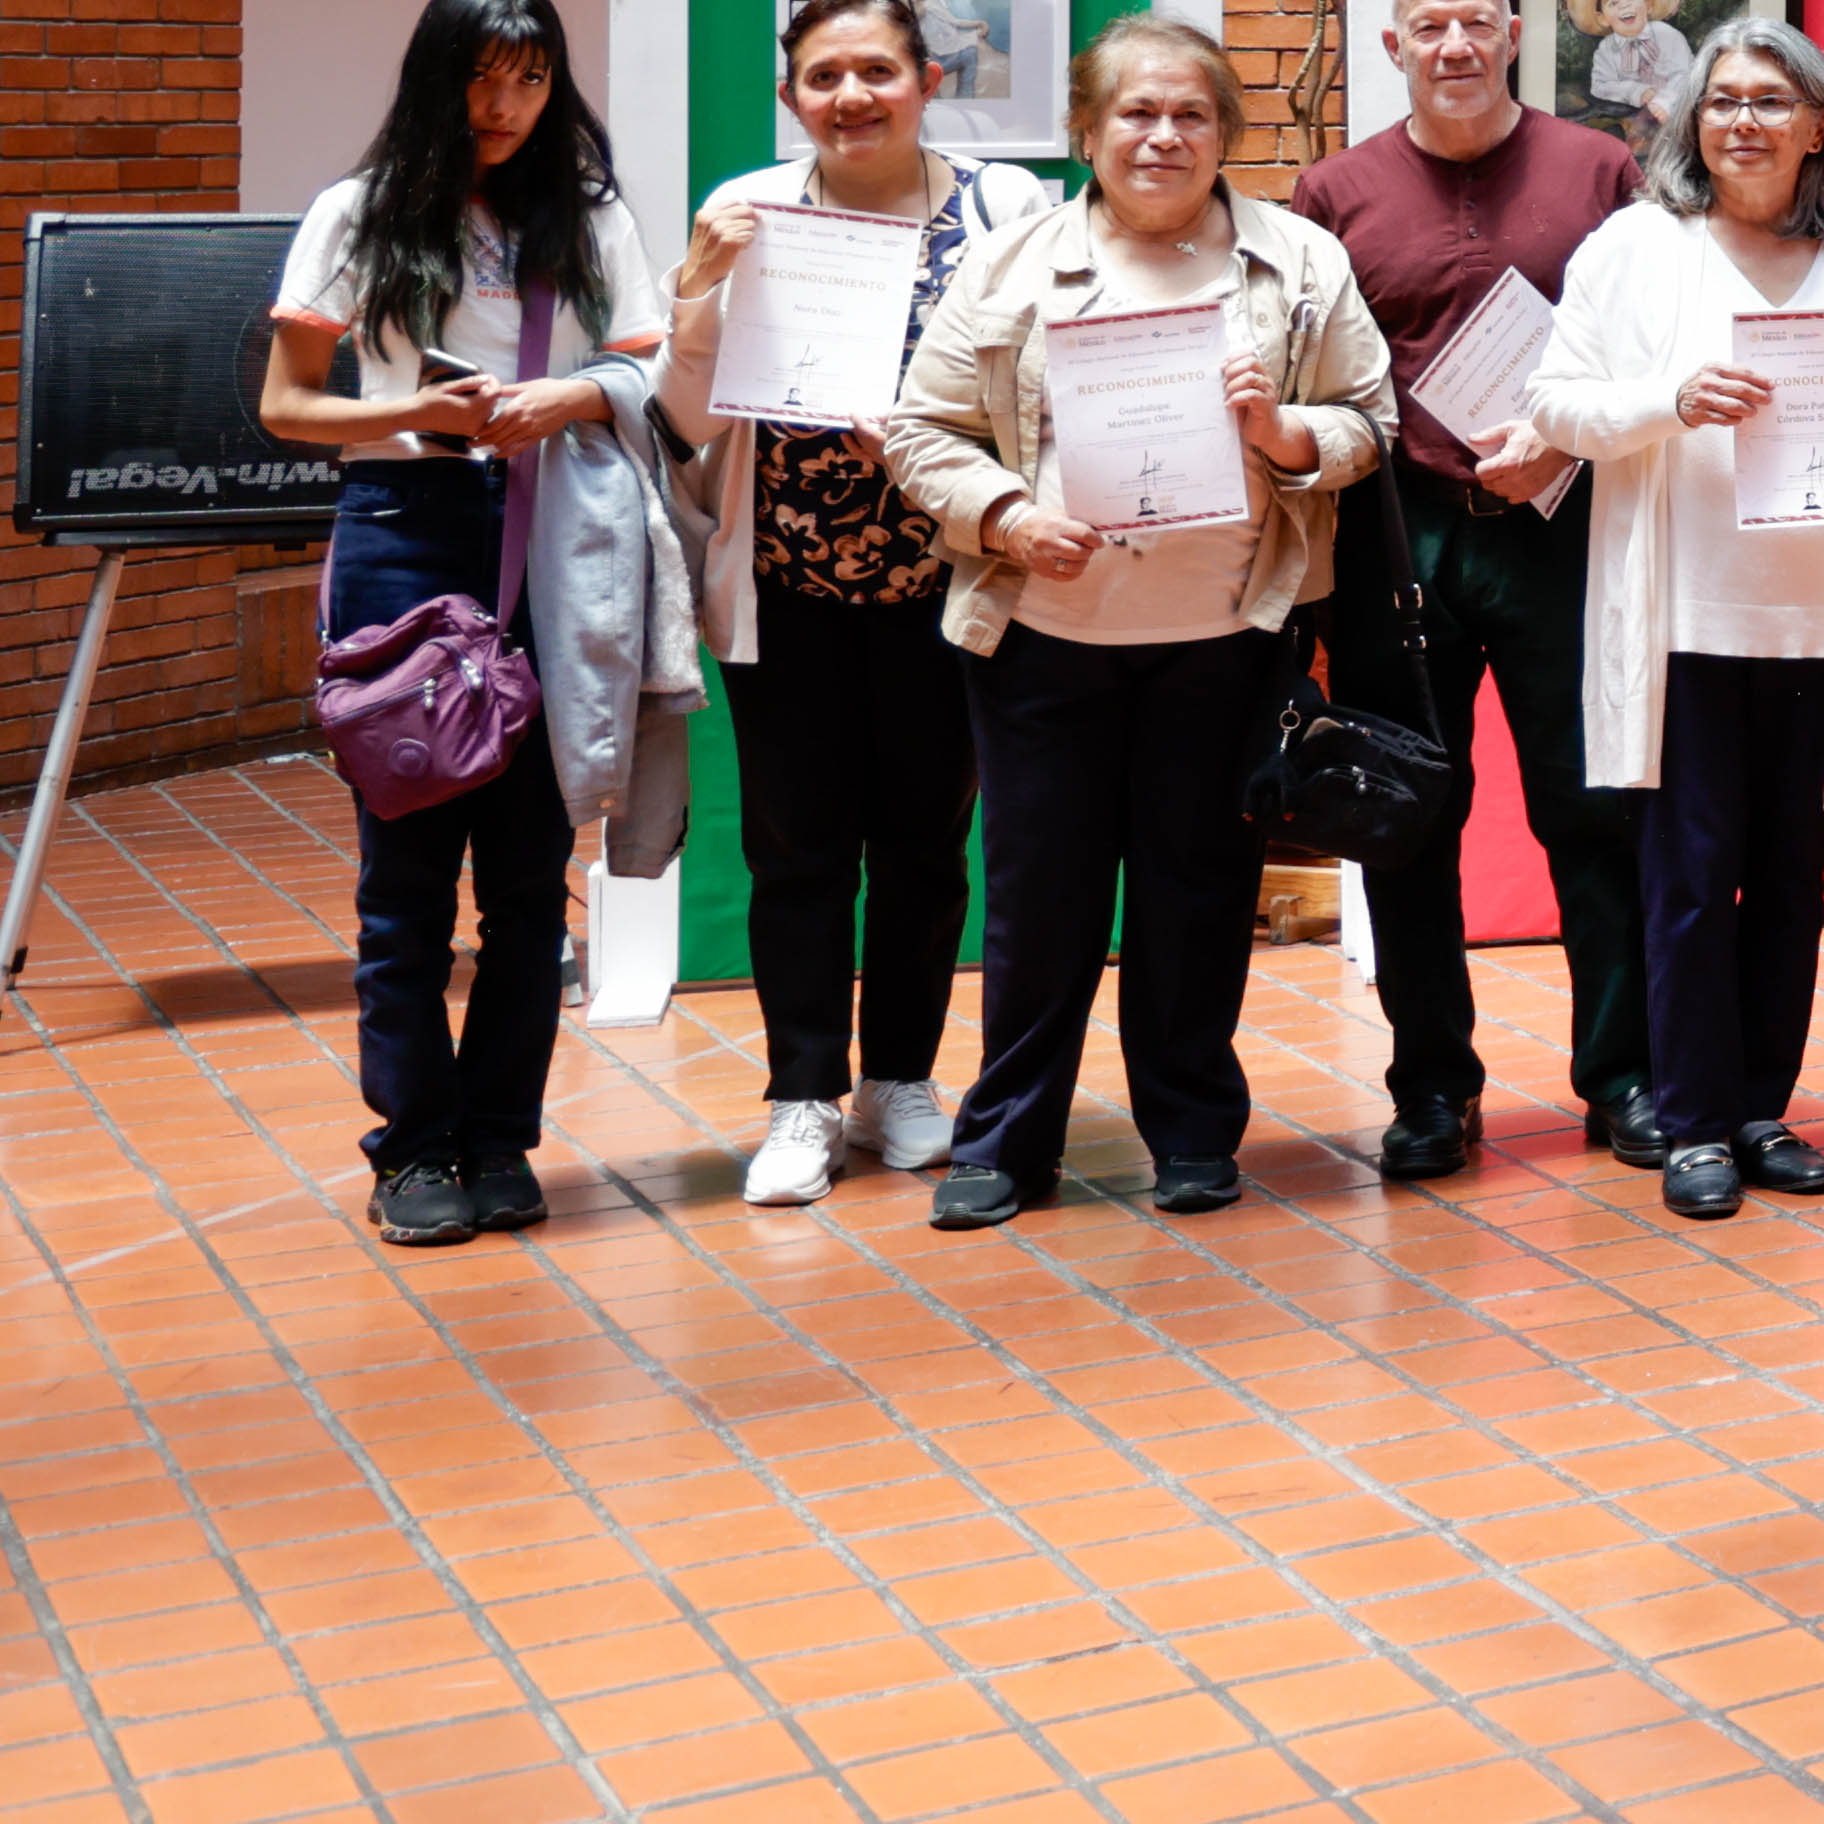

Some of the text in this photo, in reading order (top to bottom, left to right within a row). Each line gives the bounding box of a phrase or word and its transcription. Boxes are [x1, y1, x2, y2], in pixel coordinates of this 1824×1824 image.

[760, 267, 887, 292] RECONOCIMIENTO
[1077, 369, 1206, 396] RECONOCIMIENTO
[1467, 326, 1545, 419] RECONOCIMIENTO
[1118, 403, 1171, 417] Guadalupe
[1153, 413, 1185, 426] Oliver
